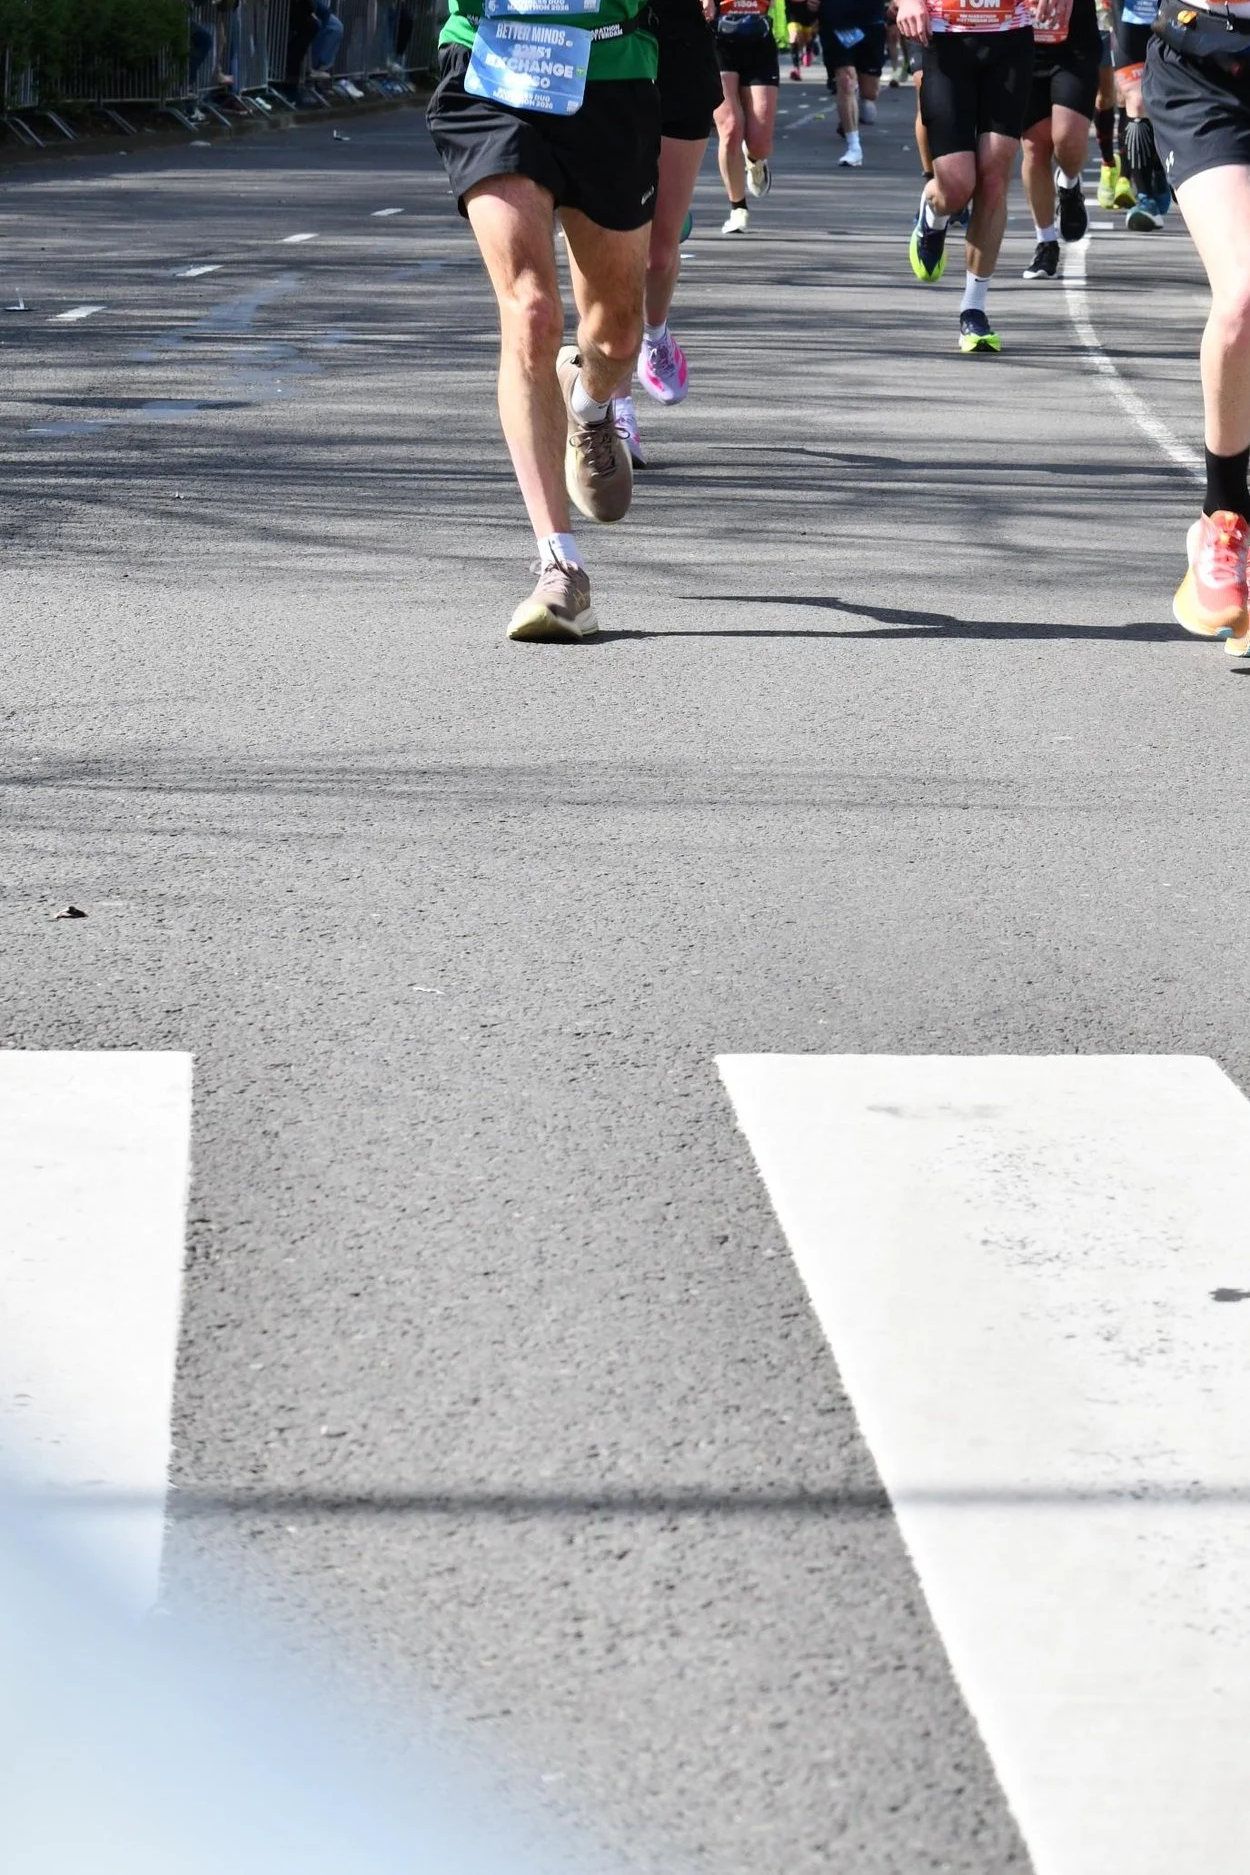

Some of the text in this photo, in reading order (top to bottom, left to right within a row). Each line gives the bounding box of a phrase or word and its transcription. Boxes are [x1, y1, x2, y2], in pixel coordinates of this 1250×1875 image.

[495, 23, 566, 47] BETTER MINDS
[485, 52, 574, 79] EXCHANGE
